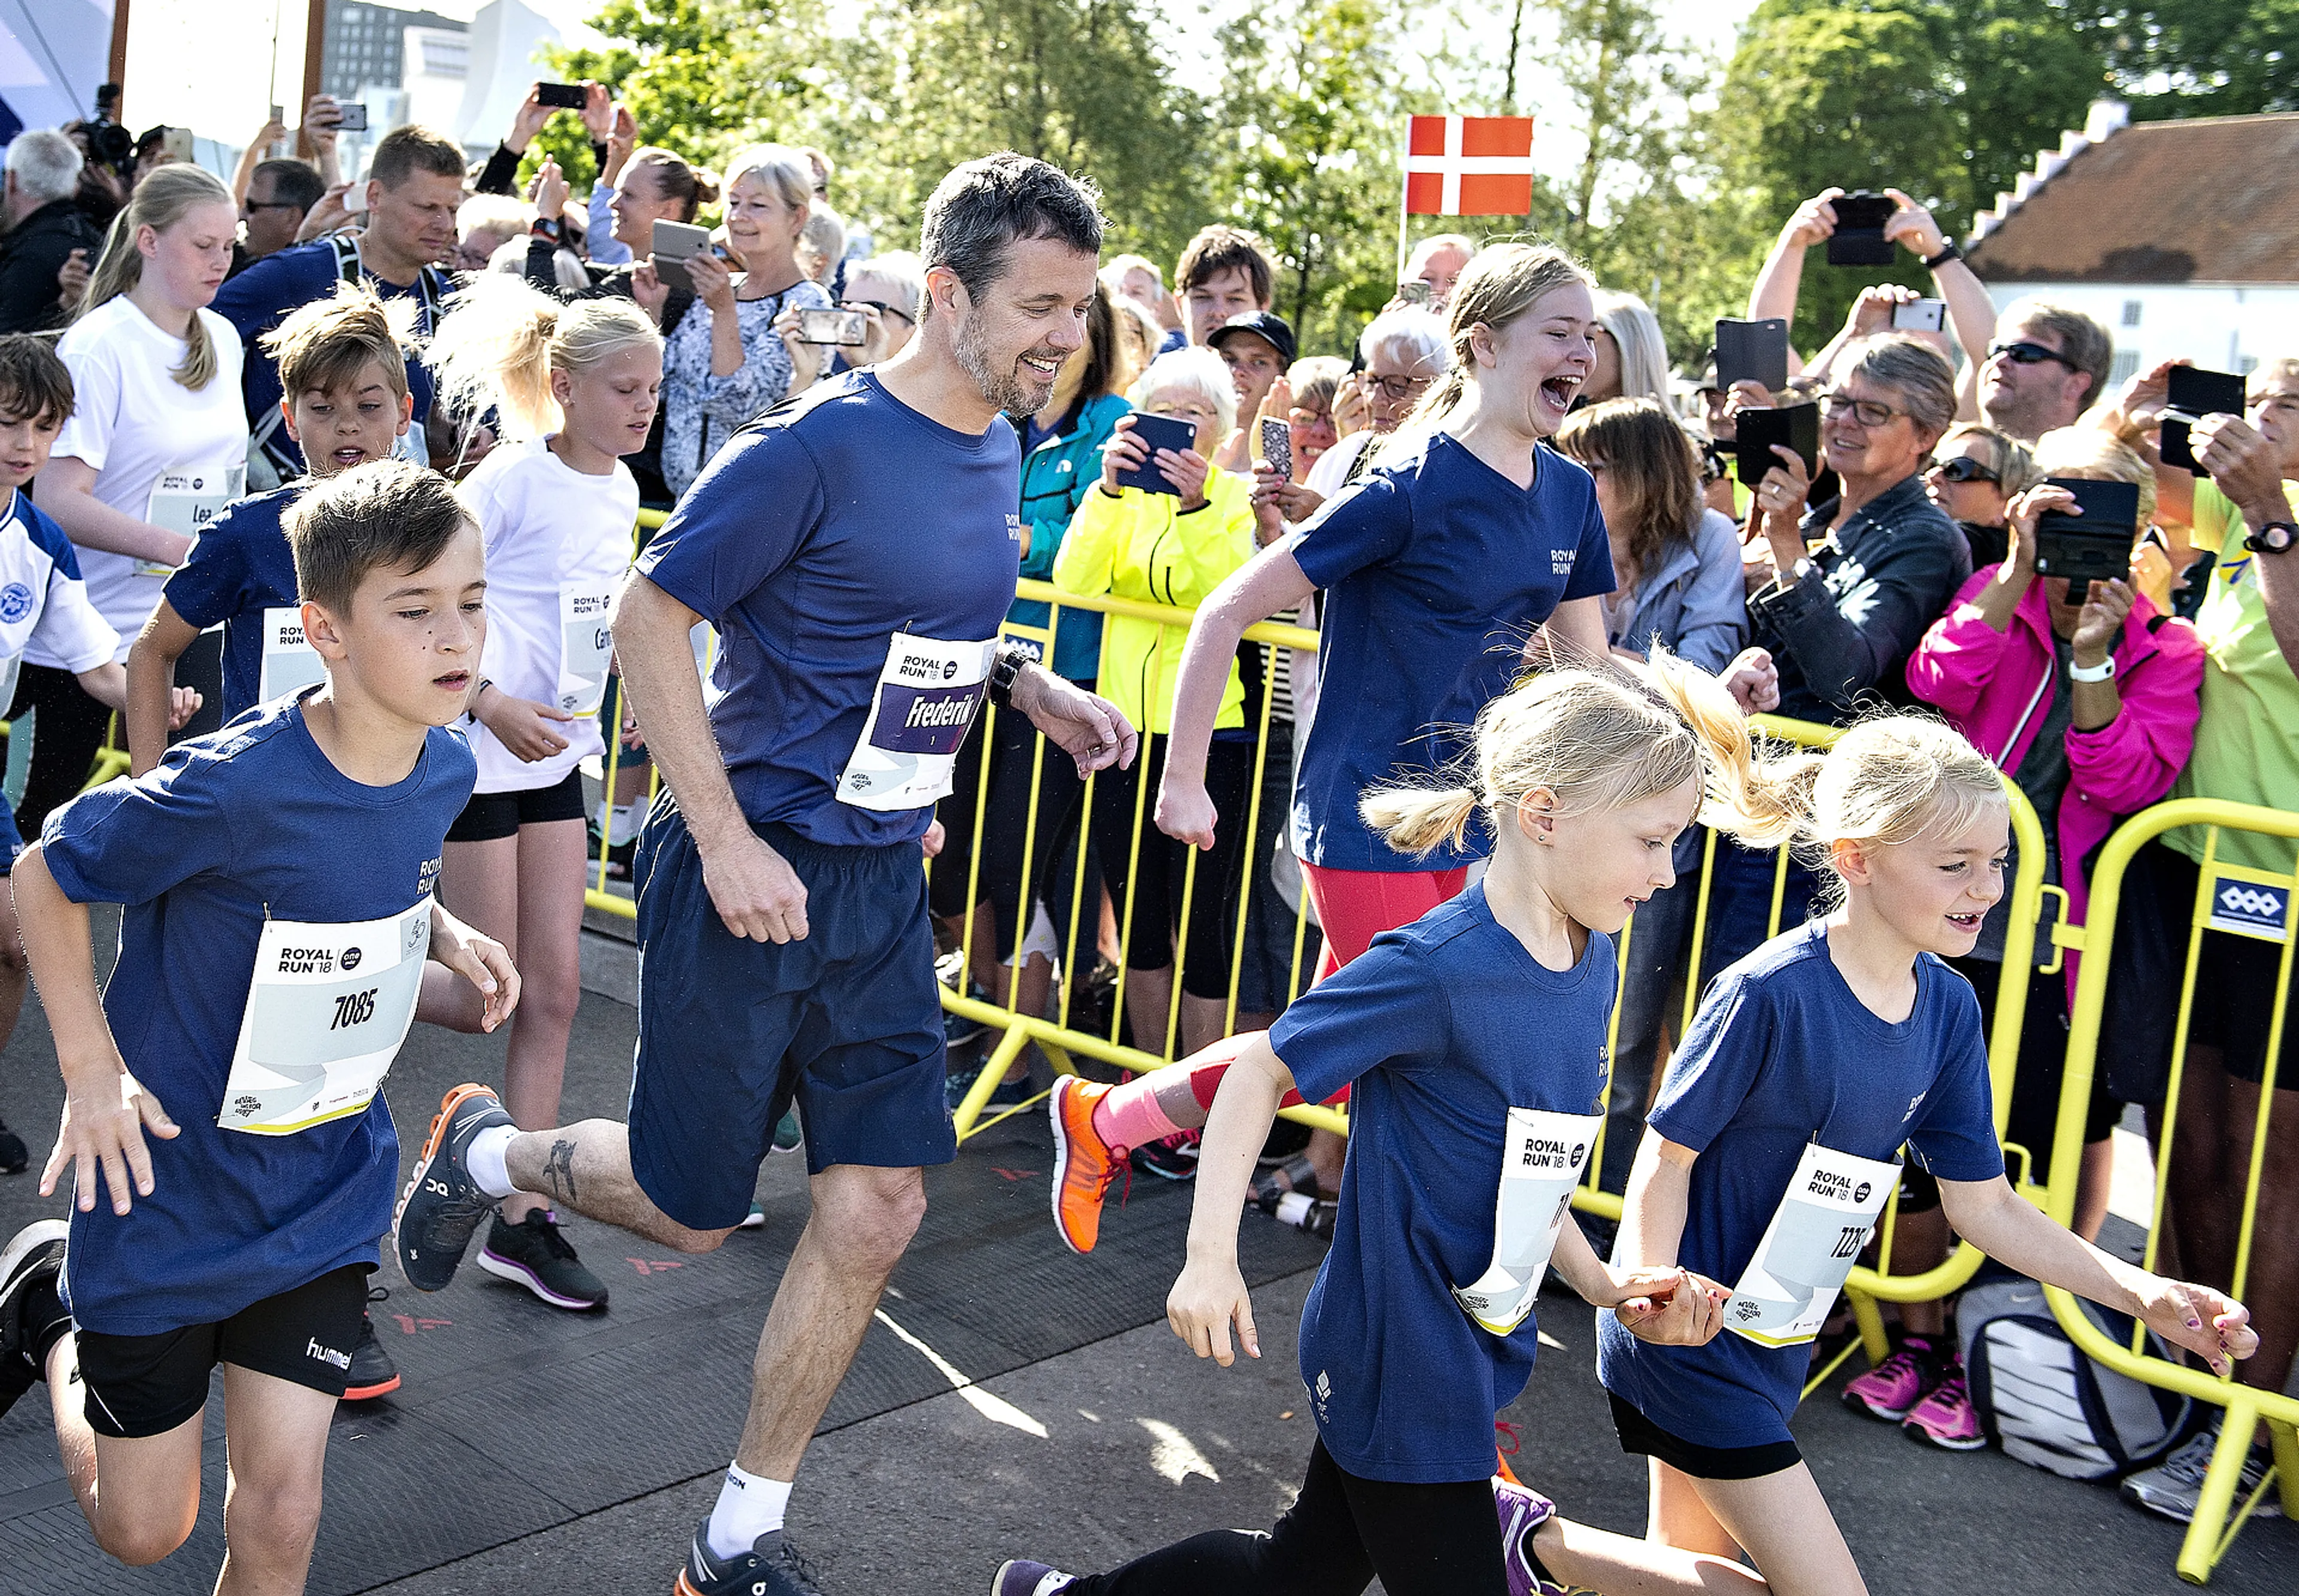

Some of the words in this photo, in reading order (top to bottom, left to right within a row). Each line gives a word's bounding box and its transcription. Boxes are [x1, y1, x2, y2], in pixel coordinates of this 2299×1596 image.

[1552, 563, 1570, 575] RUN
[574, 596, 600, 605] ROYAL
[280, 627, 305, 635] ROY
[280, 636, 304, 645] RUN
[903, 656, 940, 669] ROYAL
[899, 666, 926, 678] RUN
[905, 693, 975, 728] Frederik
[930, 735, 936, 746] 1
[281, 948, 333, 960] ROYAL
[278, 961, 314, 973] RUN
[330, 988, 378, 1030] 7085
[1525, 1139, 1566, 1154] ROYAL
[1522, 1153, 1550, 1167] RUN
[1813, 1170, 1851, 1189] ROYAL
[1808, 1181, 1836, 1197] RUN
